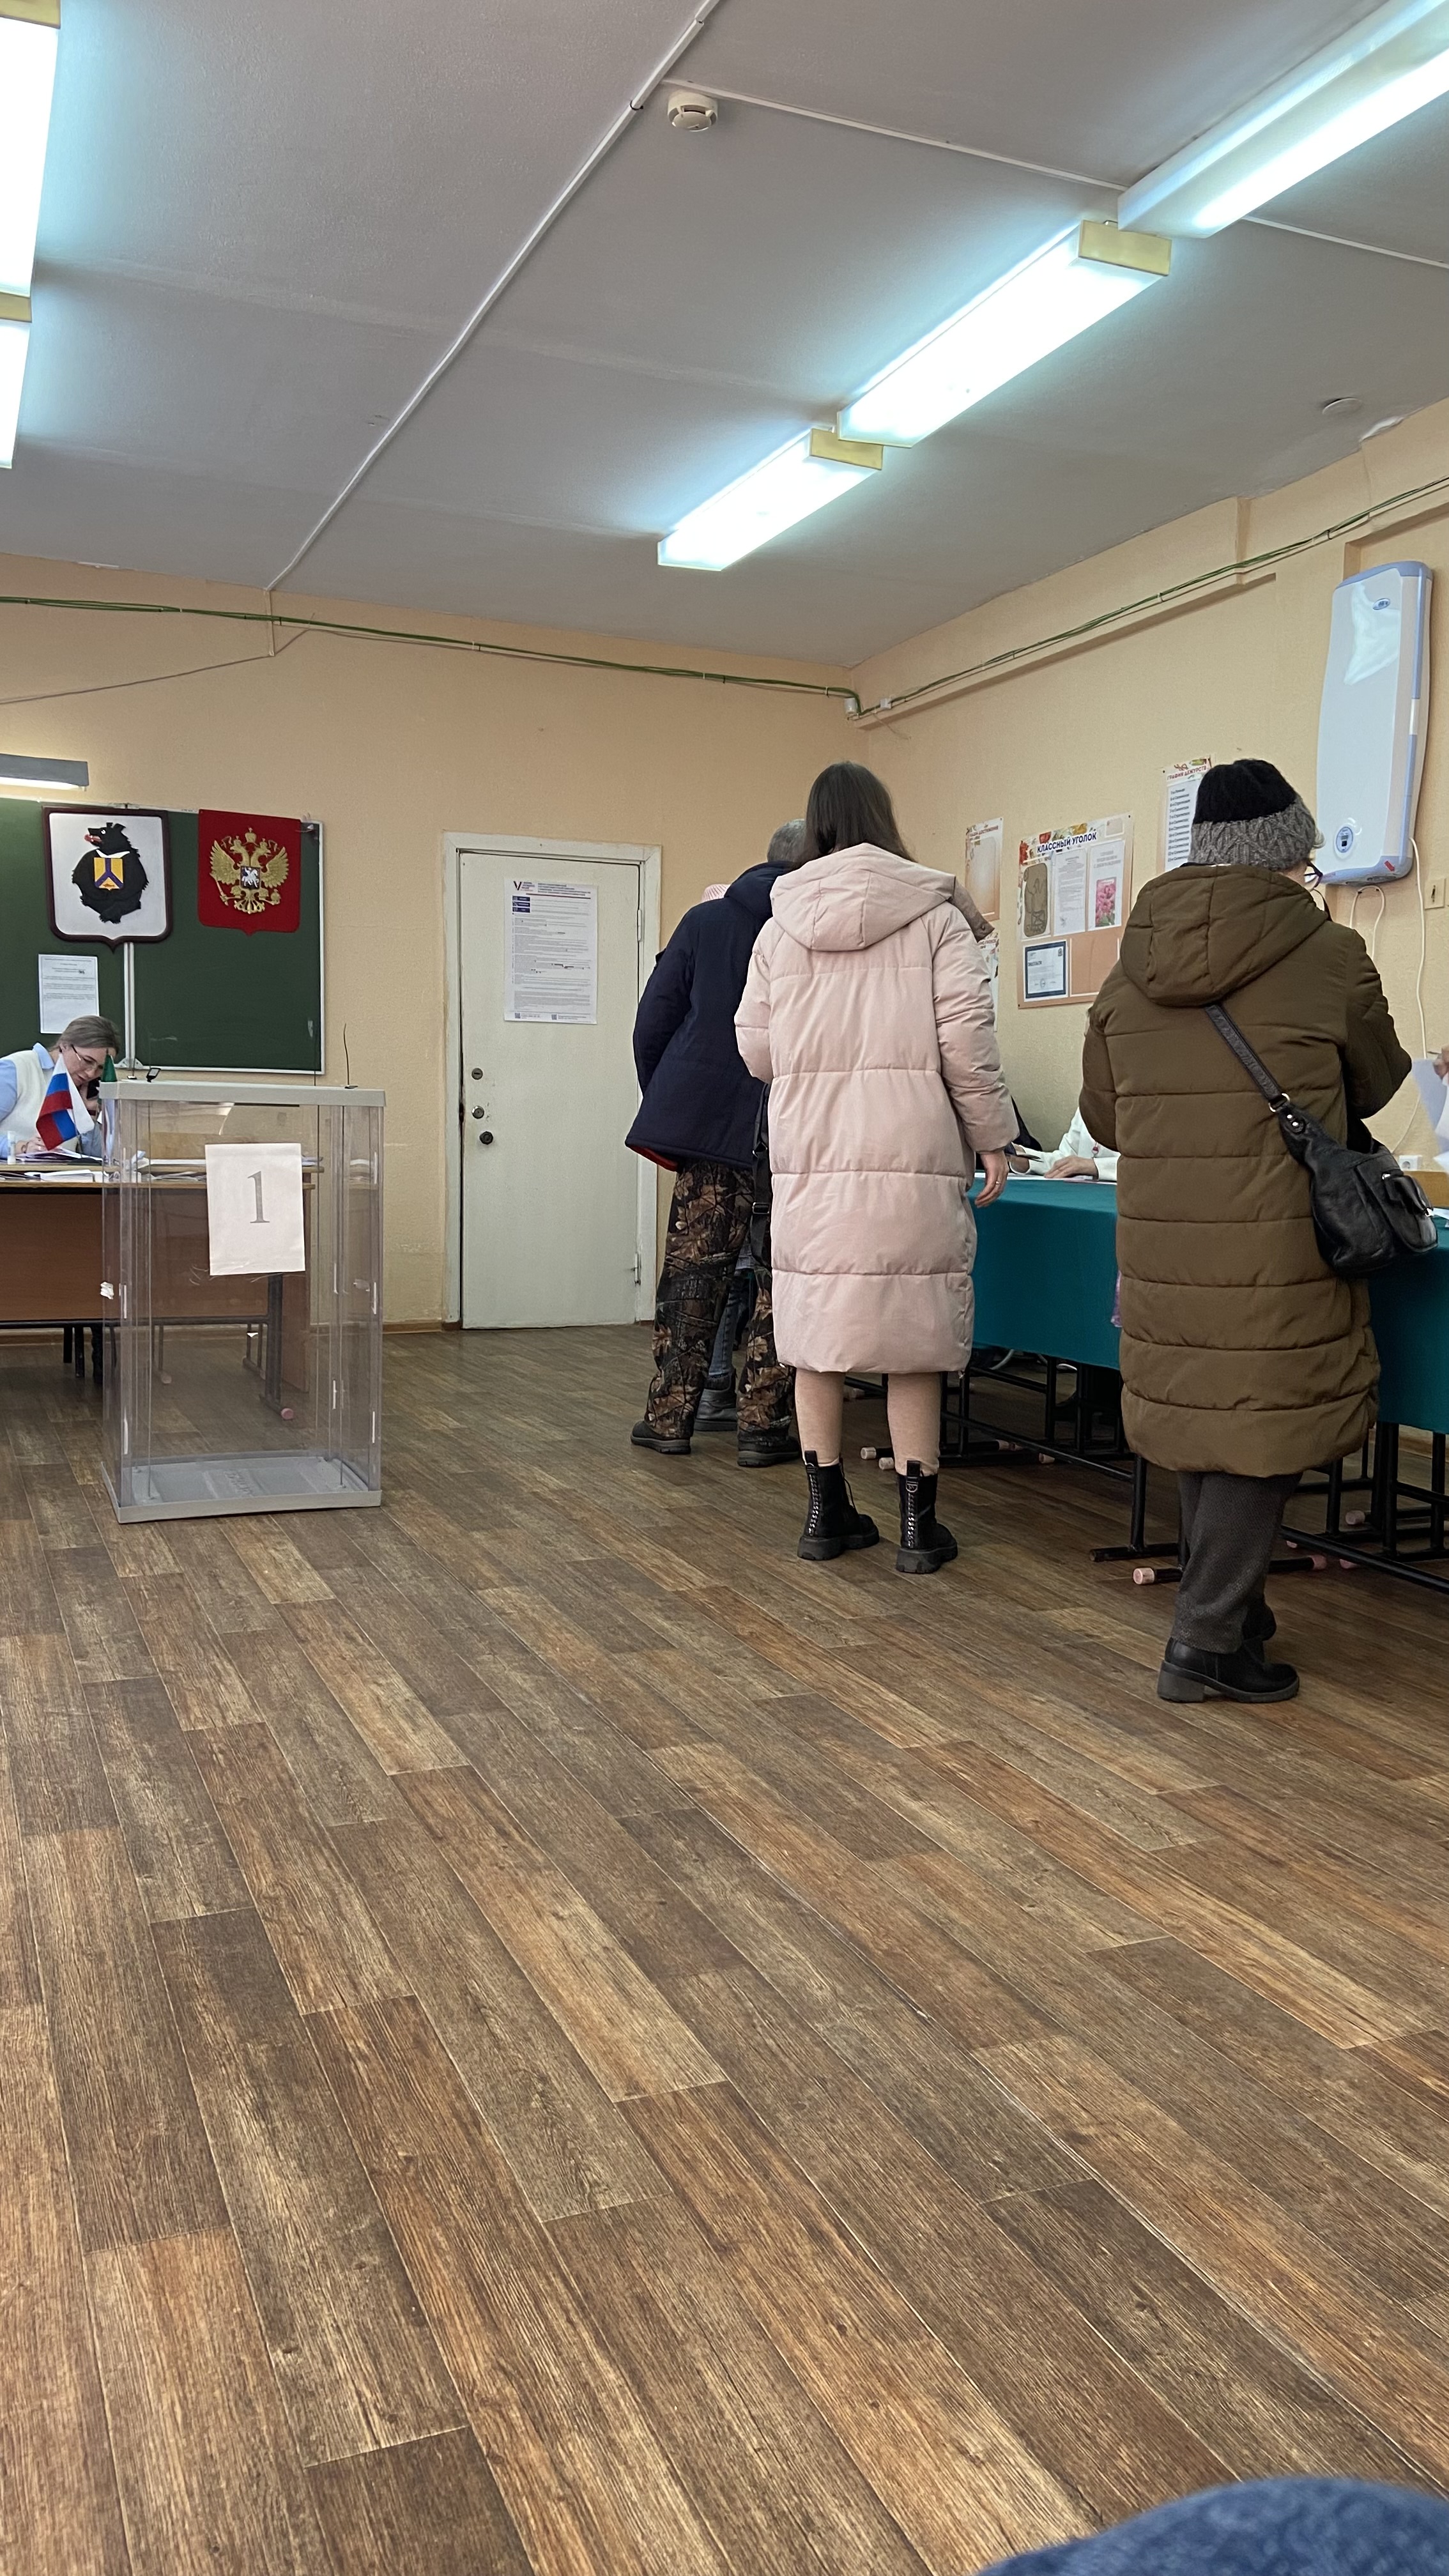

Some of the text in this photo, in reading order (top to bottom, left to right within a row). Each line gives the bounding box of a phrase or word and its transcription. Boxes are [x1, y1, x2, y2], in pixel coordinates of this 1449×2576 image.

[1037, 832, 1097, 853] КЛАССНЫЙ УГОЛОК
[247, 1171, 270, 1223] 1
